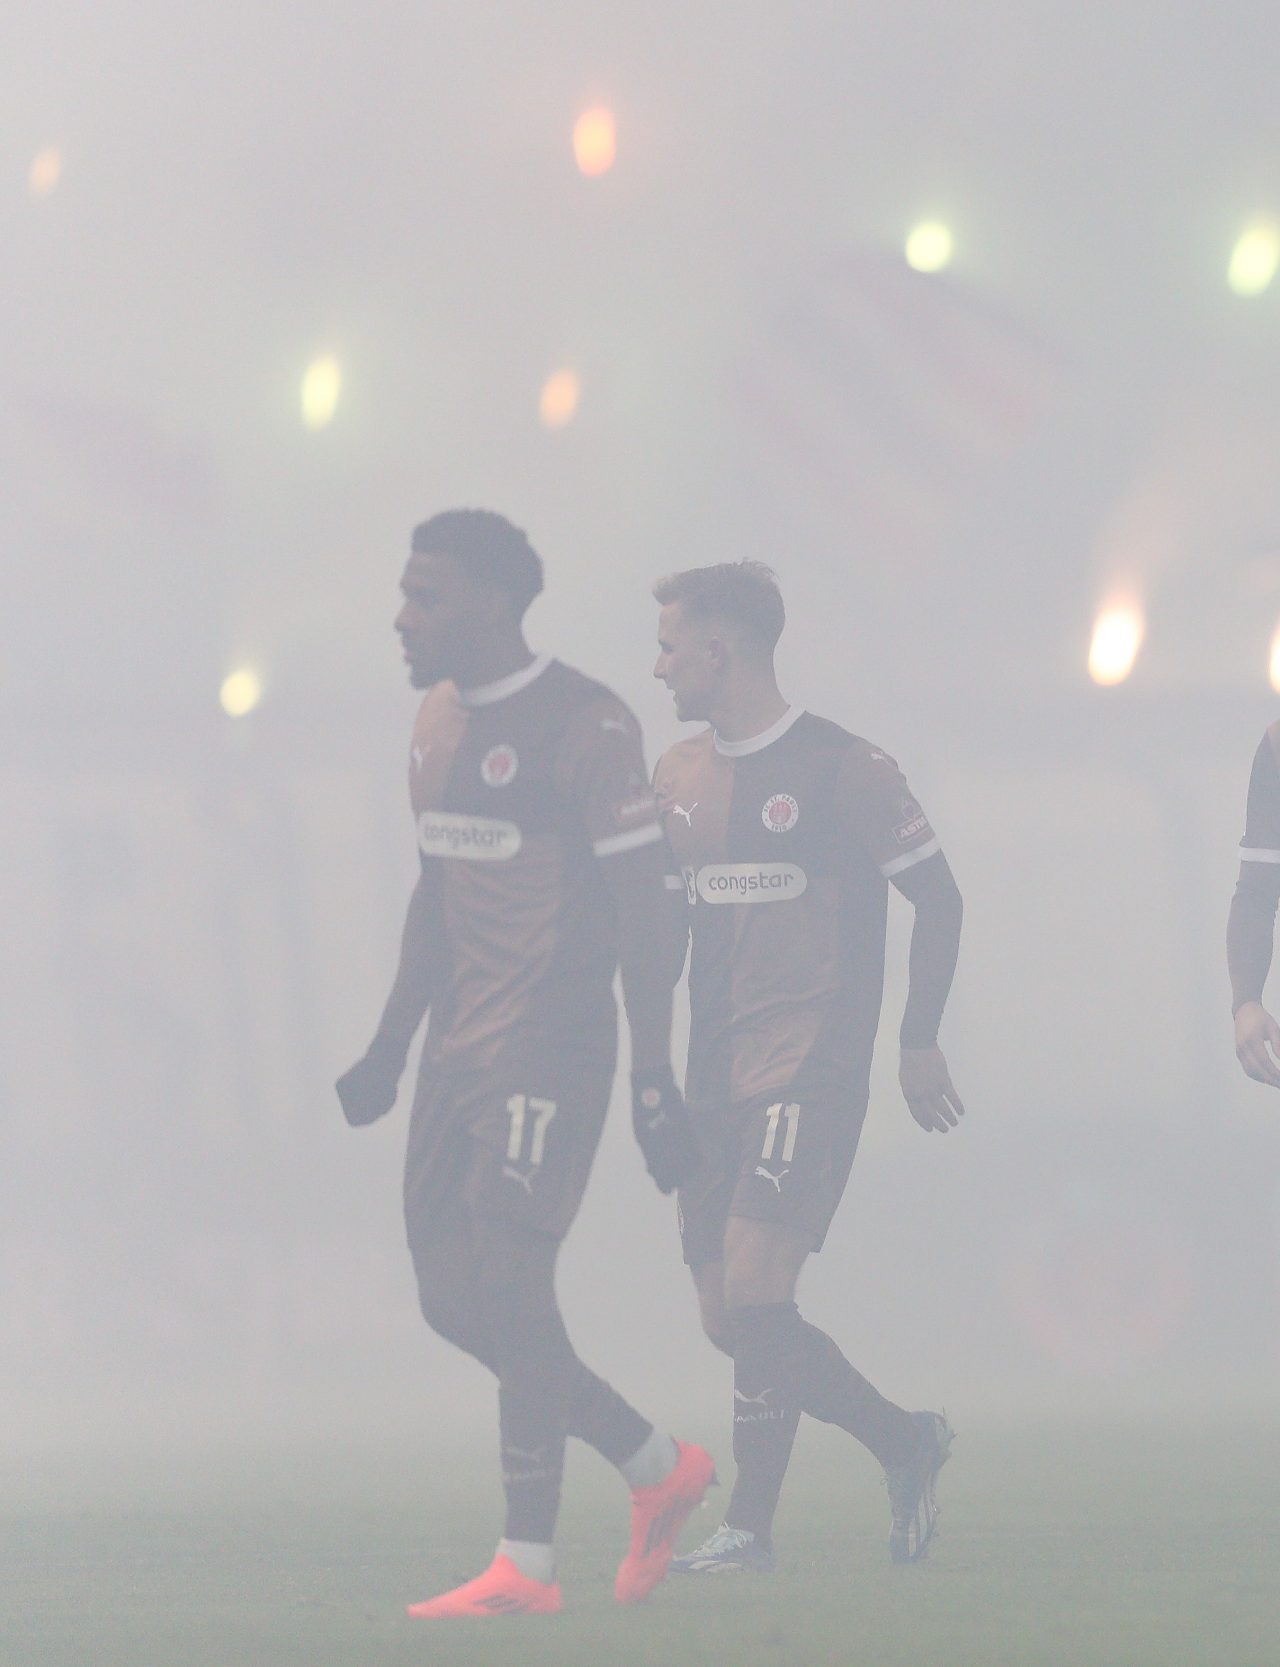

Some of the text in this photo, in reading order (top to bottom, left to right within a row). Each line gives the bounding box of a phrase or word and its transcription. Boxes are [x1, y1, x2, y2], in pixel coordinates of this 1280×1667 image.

[707, 871, 794, 895] congstar
[506, 1094, 557, 1165] 17
[761, 1103, 801, 1162] 11
